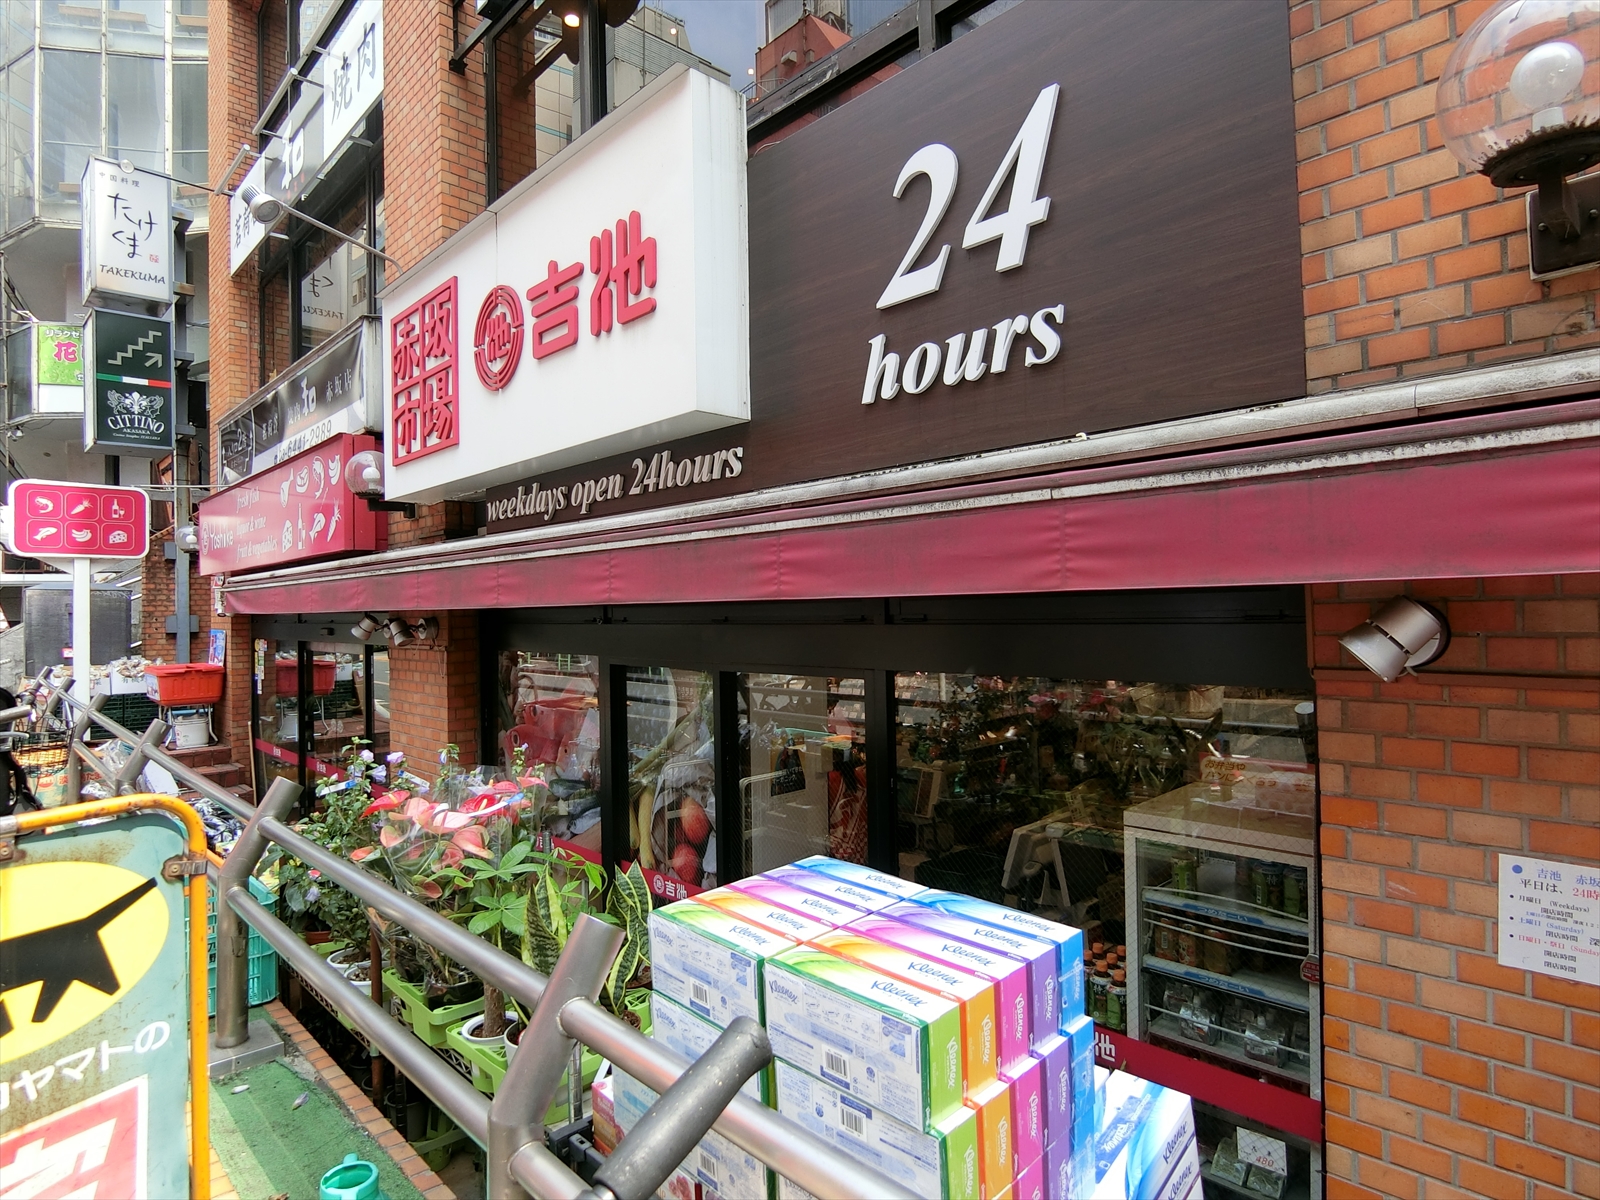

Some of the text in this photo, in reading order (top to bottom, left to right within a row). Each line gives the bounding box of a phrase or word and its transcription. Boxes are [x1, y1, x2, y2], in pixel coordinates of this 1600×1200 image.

[331, 21, 377, 126] 焼肉
[98, 171, 141, 188] 中国料理
[875, 82, 1060, 310] 24
[99, 263, 166, 285] TAKEKUMA
[526, 210, 657, 361] 吉池
[46, 329, 83, 339] リラクゼ
[861, 303, 1065, 405] hours
[107, 414, 165, 434] CITTINO
[122, 428, 151, 436] AKASAKA
[487, 446, 744, 522] weekdays open 24hours
[865, 874, 907, 890] Kleenex
[1536, 867, 1562, 882] 吉池
[834, 886, 876, 902] Kleenex
[801, 898, 842, 916] Kleenex
[1549, 900, 1590, 913] (Weekdays)
[766, 911, 808, 931] Kleenex
[1002, 913, 1056, 933] Kleenex
[1547, 923, 1584, 935] (Saturday)
[729, 925, 771, 946] Kleenex
[974, 928, 1027, 949] Kleenex
[941, 944, 996, 967] Kleenex
[907, 961, 963, 987] Kleenex
[768, 979, 800, 1005] Kleenex
[870, 980, 928, 1008] Kleenex
[1045, 974, 1055, 1022] Kleenex
[1014, 993, 1025, 1042] Kleenex
[981, 1014, 993, 1066] Kleenex
[946, 1036, 959, 1091] Kleenex
[1058, 1066, 1070, 1114] Kleenex
[1028, 1091, 1039, 1140] Kleenex
[998, 1116, 1008, 1168] Kleenex
[1163, 1121, 1188, 1165] Kleenex
[964, 1144, 975, 1197] Kleenex
[1256, 1155, 1274, 1167] 480
